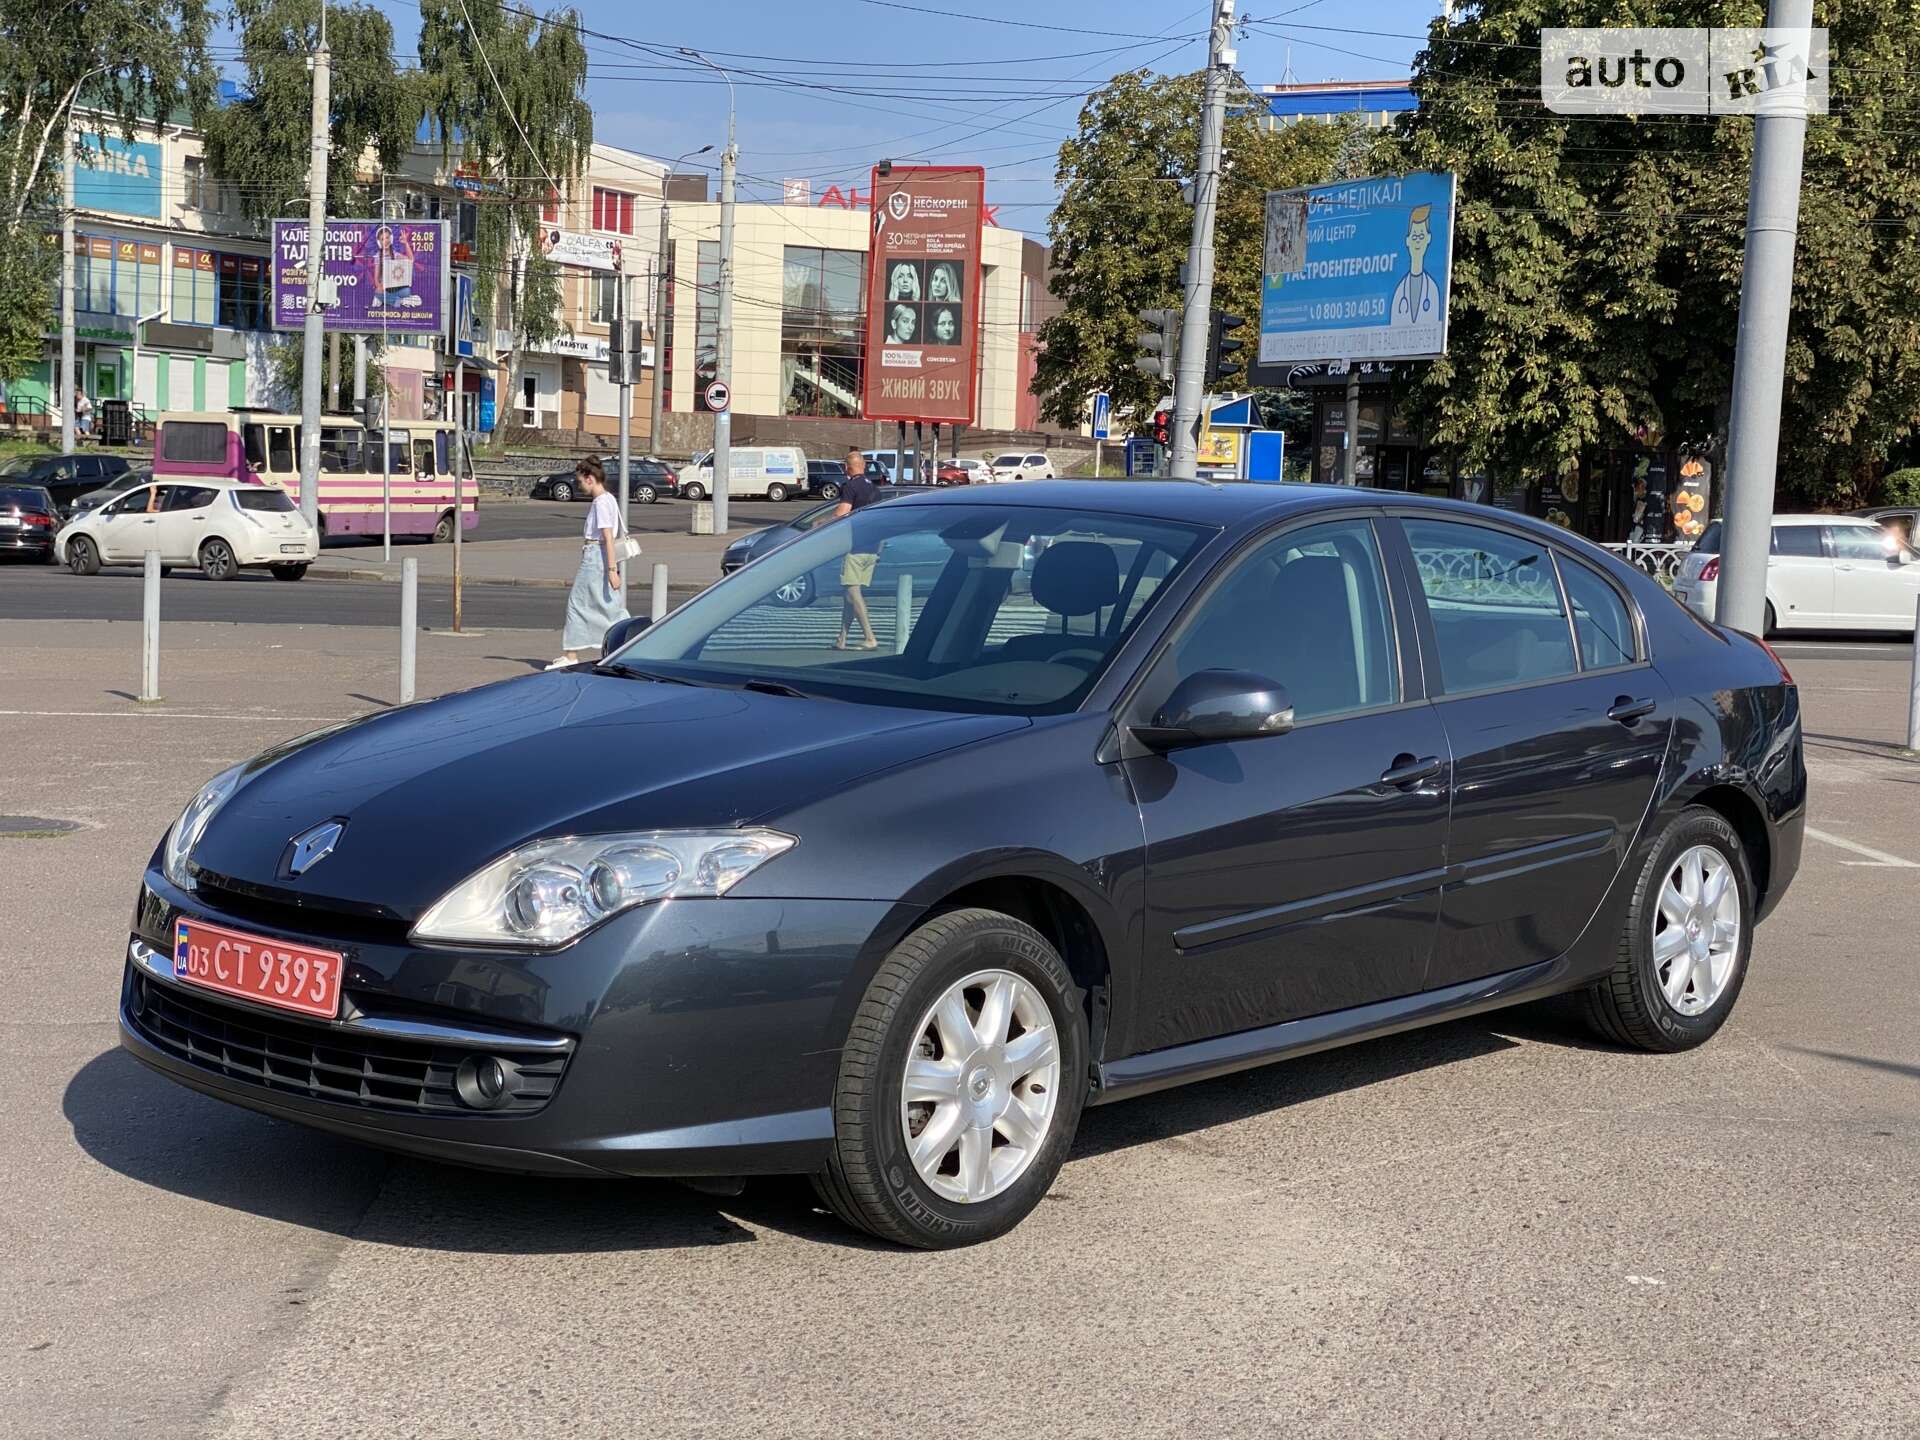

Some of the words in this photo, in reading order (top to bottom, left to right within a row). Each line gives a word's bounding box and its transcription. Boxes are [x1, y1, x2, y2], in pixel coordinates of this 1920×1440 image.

[1337, 181, 1401, 210] МЕДІКАЛ
[913, 199, 968, 209] НЕСКОРЕНІ
[281, 230, 362, 243] КАЛЕОСКОП
[411, 231, 434, 242] 26.08
[886, 232, 903, 245] 30
[1326, 224, 1357, 242] ЦЕНТР
[411, 242, 434, 252] 12:00
[1323, 304, 1341, 320] 800
[1344, 302, 1357, 318] 30
[1357, 300, 1370, 317] 40
[1372, 298, 1385, 315] 50
[881, 376, 925, 399] ЖИВИЙ
[928, 379, 960, 401] ЗВУК
[177, 955, 187, 971] UA
[258, 950, 329, 1003] 9393
